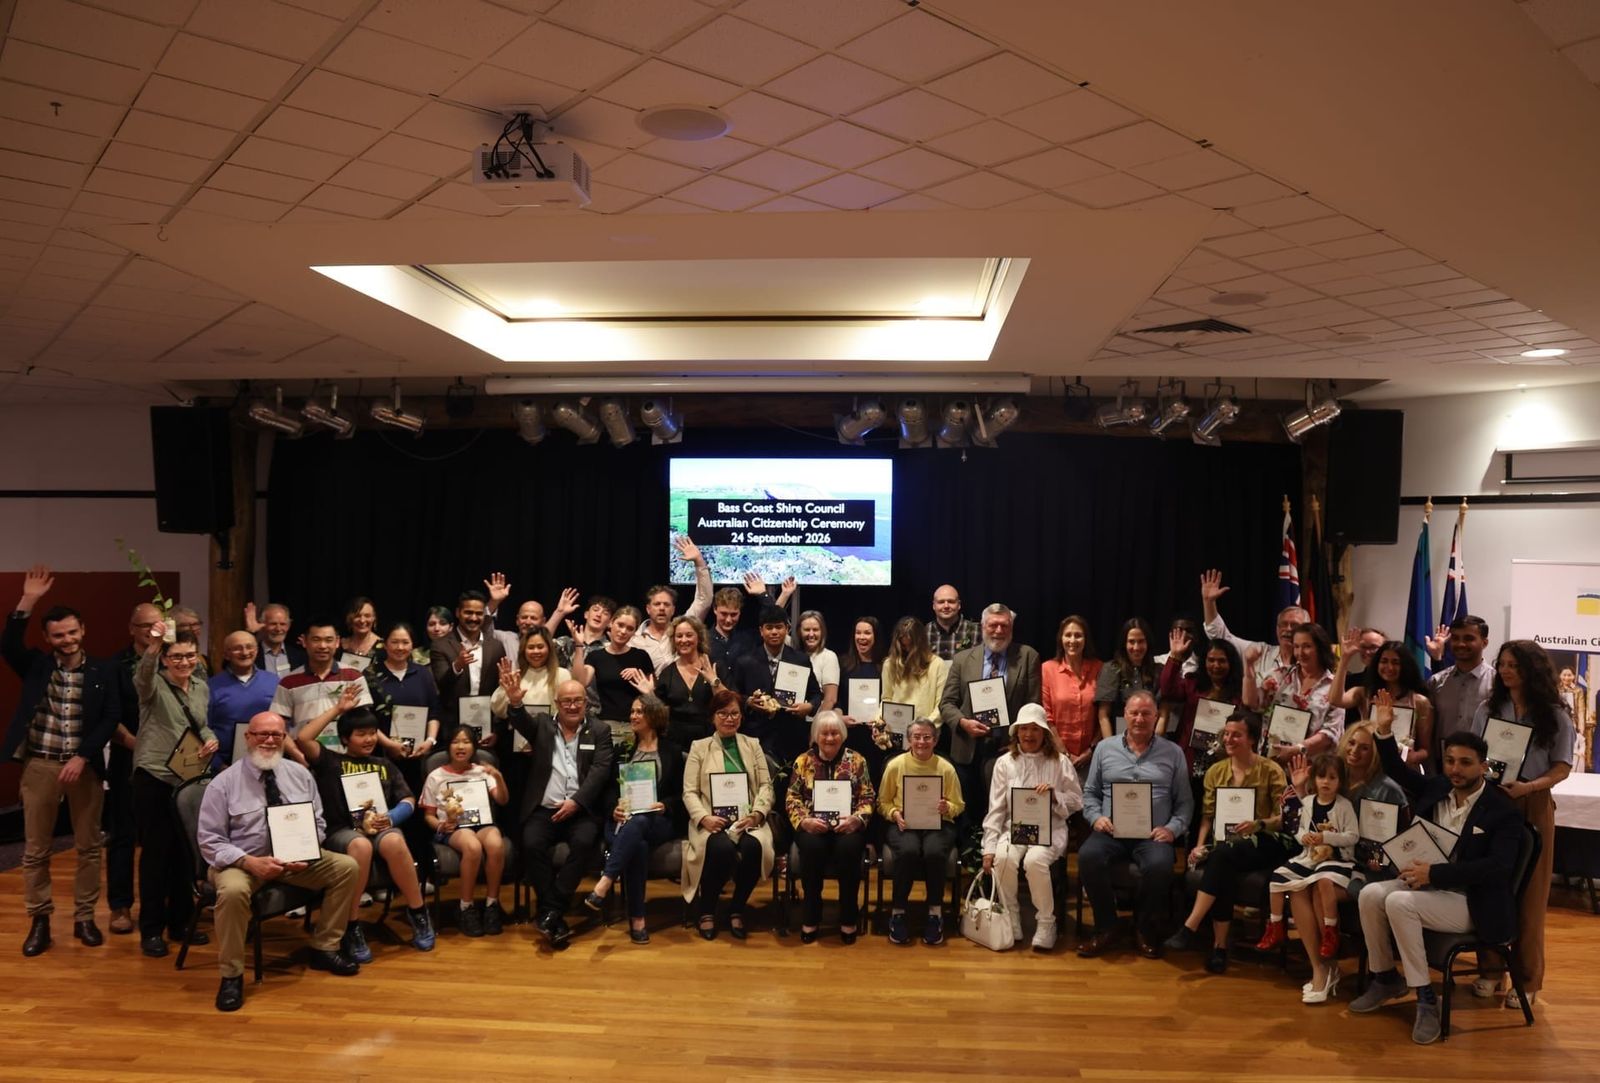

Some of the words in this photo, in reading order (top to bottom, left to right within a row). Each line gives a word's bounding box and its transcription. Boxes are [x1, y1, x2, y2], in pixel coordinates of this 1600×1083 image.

[718, 502, 740, 514] Bass
[743, 502, 774, 514] Coast
[776, 502, 802, 514] Shire
[805, 503, 845, 514] Council
[698, 517, 749, 528] Australian
[752, 517, 808, 531] Citizenship
[811, 518, 866, 531] Ceremony
[731, 532, 744, 543] 24
[747, 533, 802, 545] September
[805, 533, 831, 544] 2026
[1533, 634, 1587, 646] Australian
